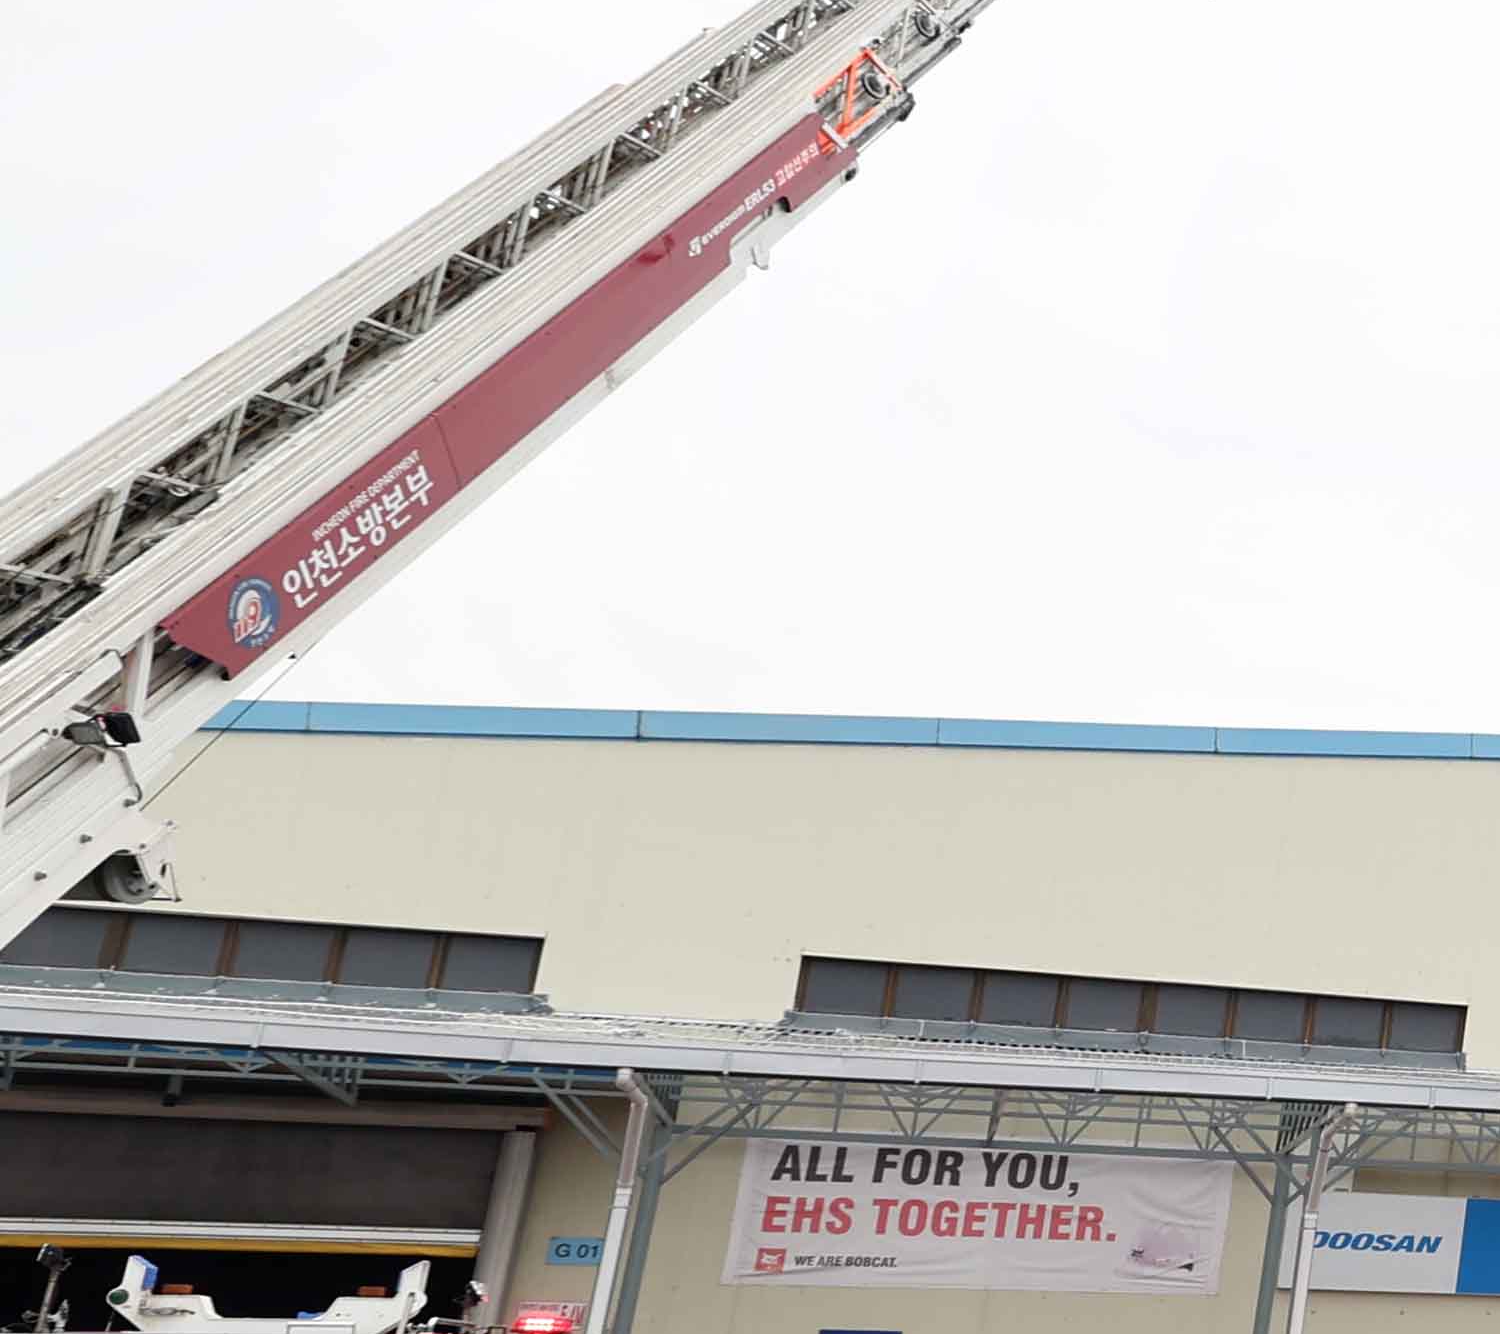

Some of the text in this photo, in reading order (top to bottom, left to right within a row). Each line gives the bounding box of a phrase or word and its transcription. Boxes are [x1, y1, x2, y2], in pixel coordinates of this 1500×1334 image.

[283, 465, 433, 608] 인천소방본부
[771, 1145, 1080, 1198] ALL FOR YOU,
[760, 1196, 1117, 1243] EHS TOGETHER.
[555, 1243, 600, 1258] G 01
[1313, 1231, 1443, 1254] DOOSAN
[794, 1255, 816, 1267] WE
[818, 1255, 844, 1267] ARE
